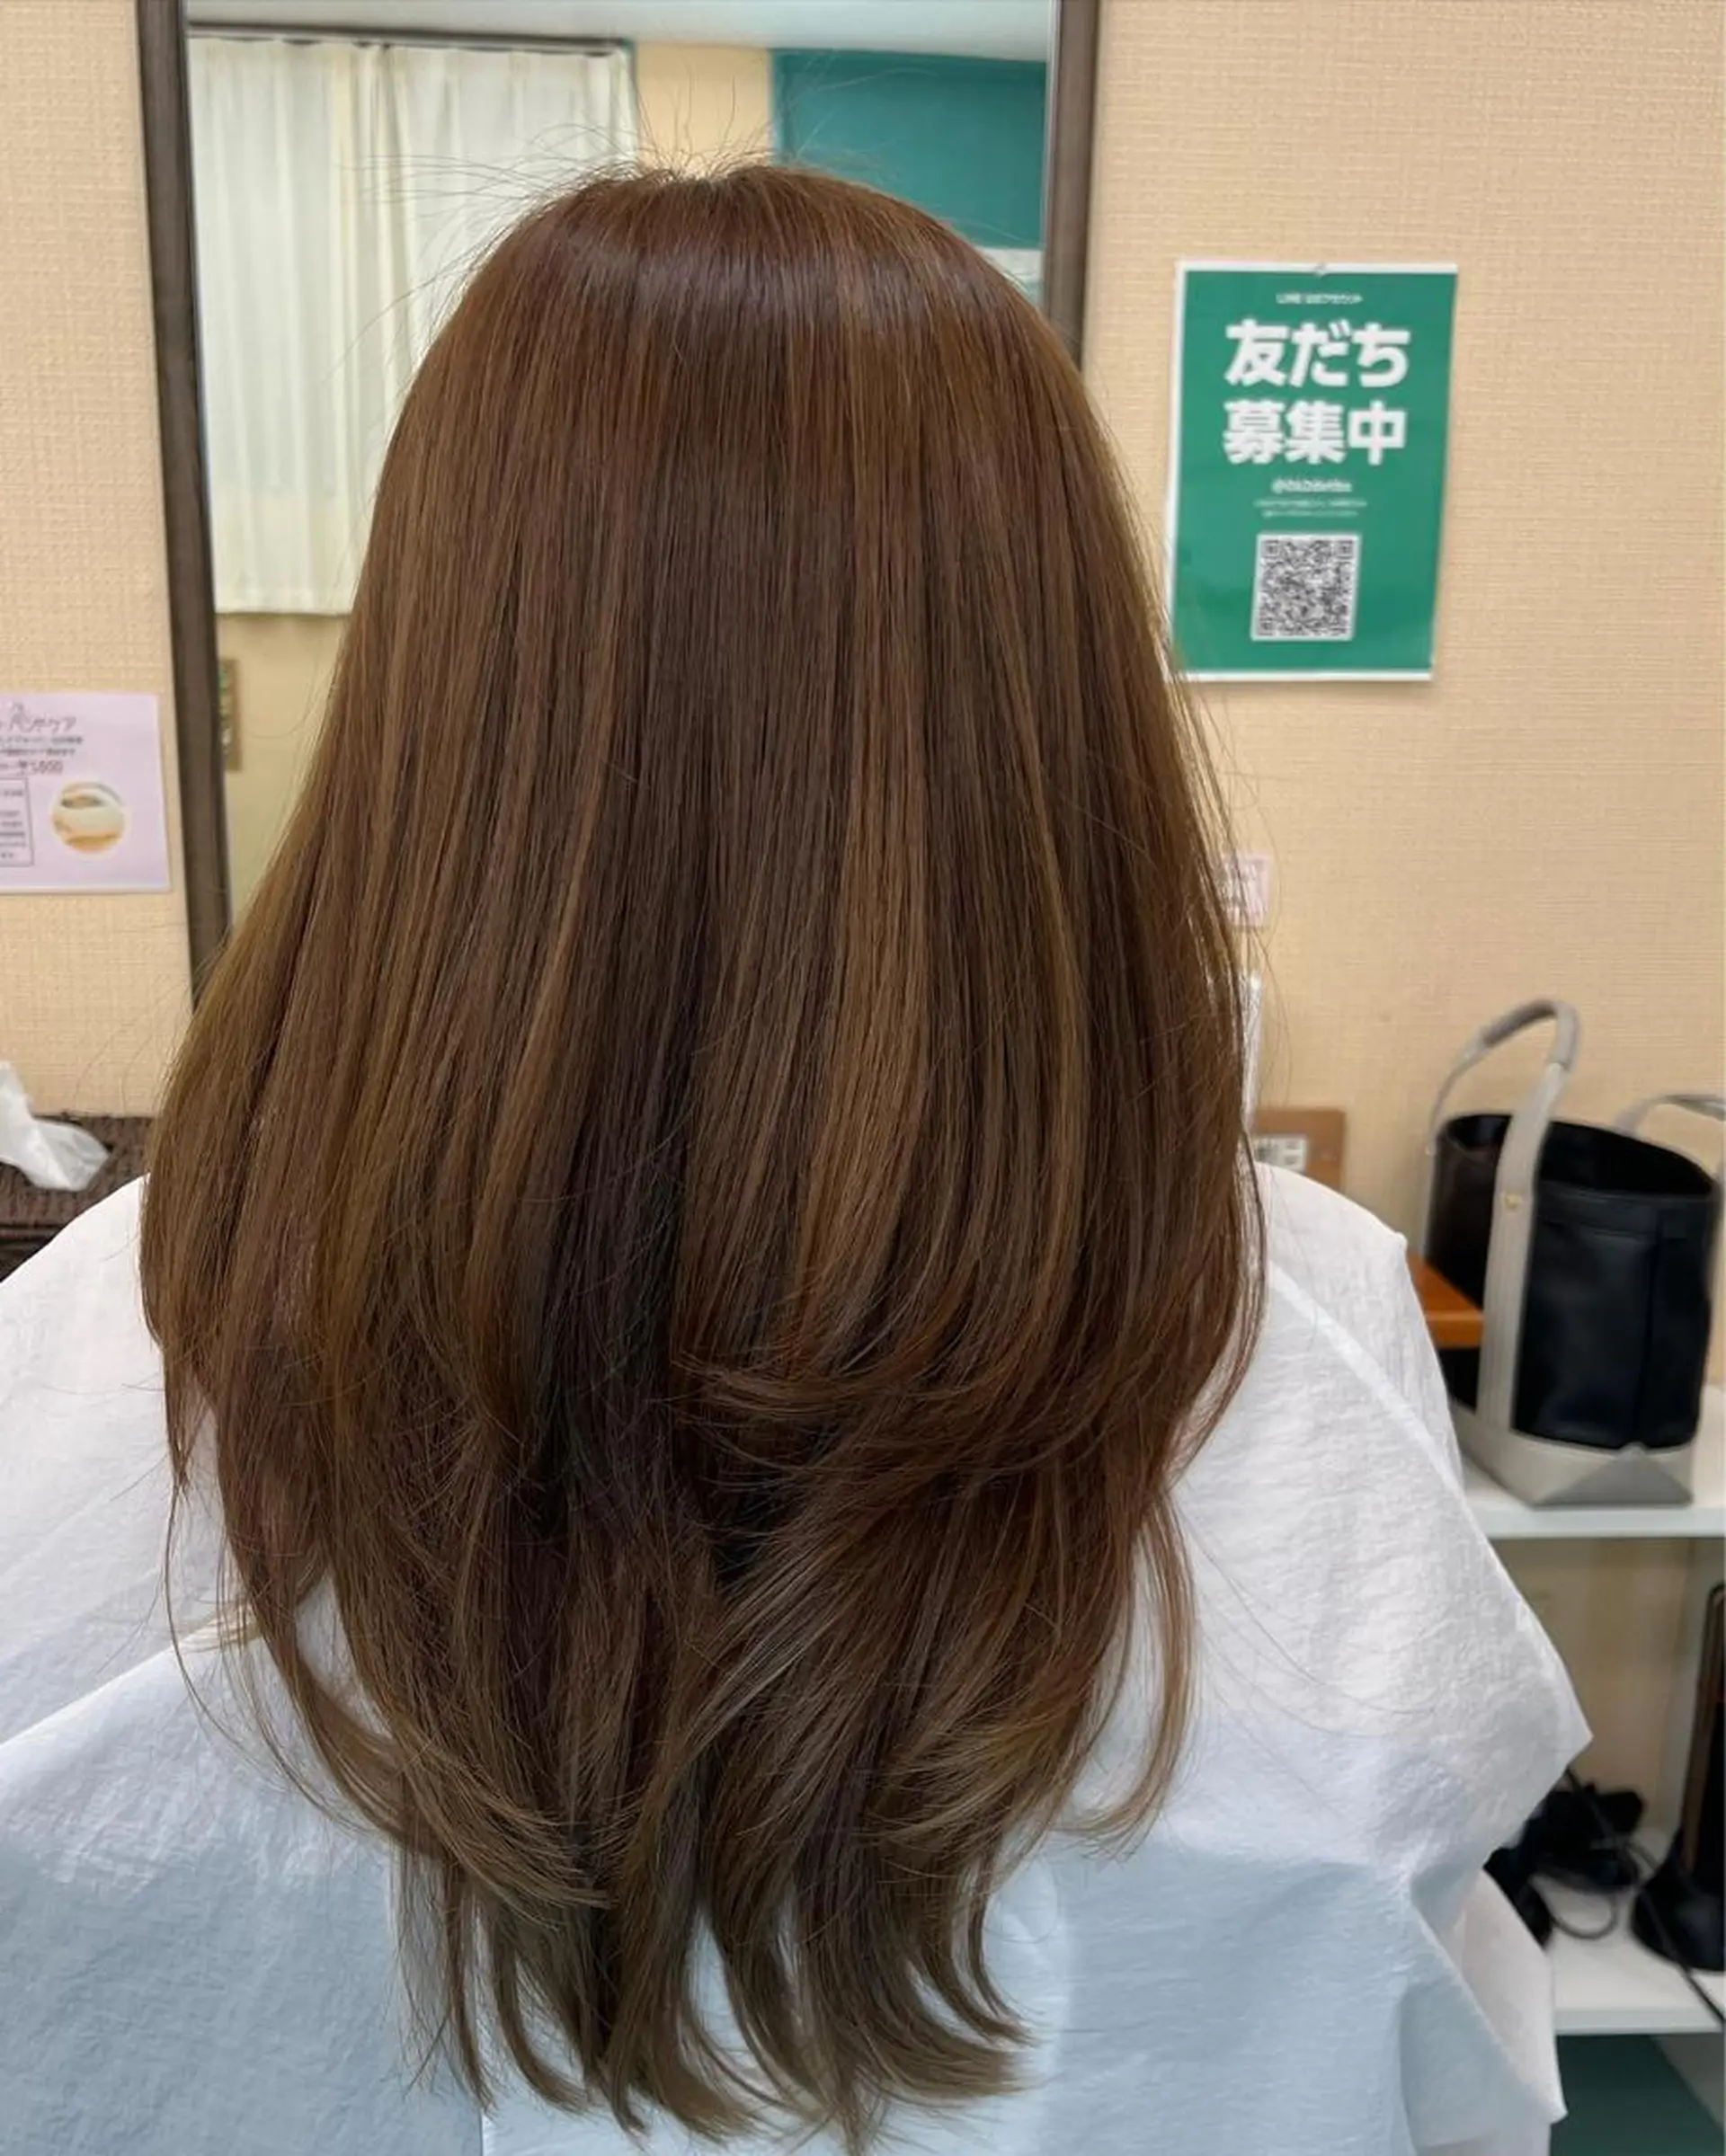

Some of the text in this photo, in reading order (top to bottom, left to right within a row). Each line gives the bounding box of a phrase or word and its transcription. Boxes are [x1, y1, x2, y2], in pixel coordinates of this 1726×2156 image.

[1223, 318, 1411, 388] 友だち
[1223, 399, 1409, 466] 募集中
